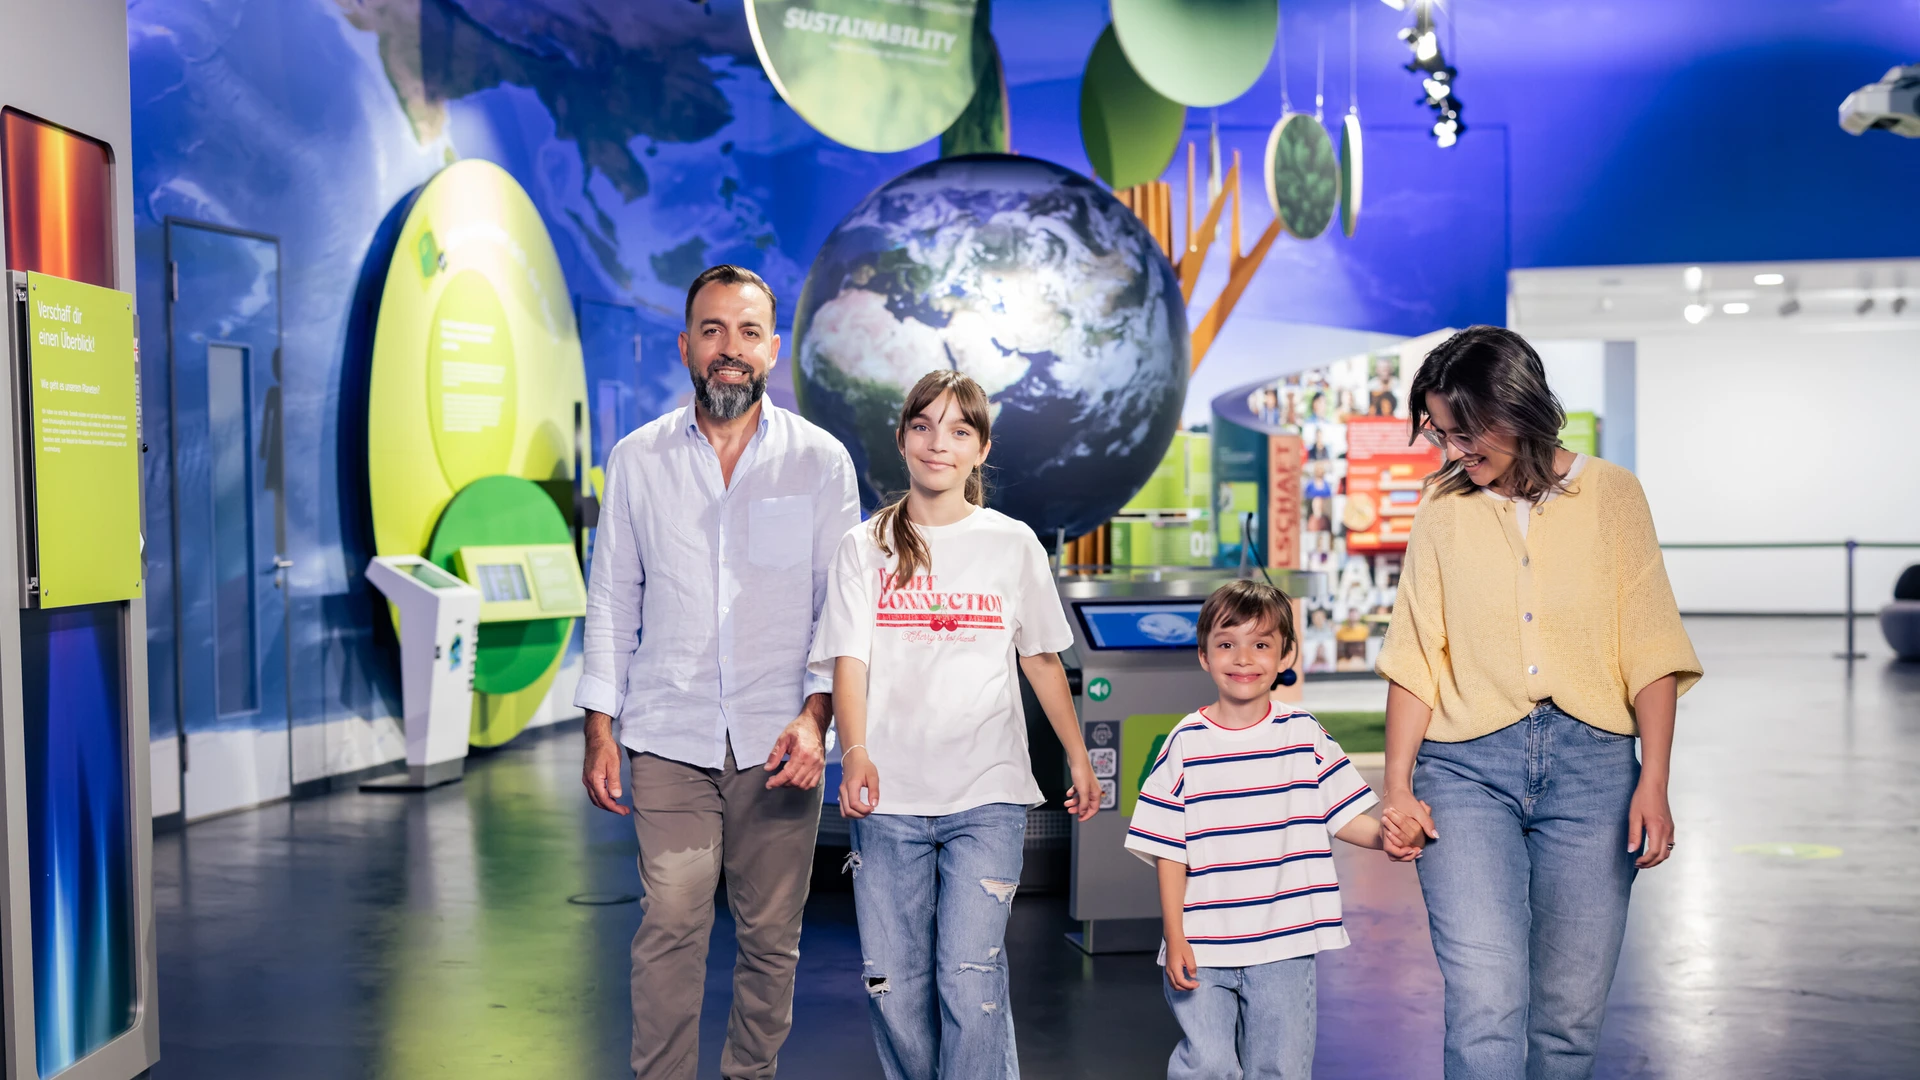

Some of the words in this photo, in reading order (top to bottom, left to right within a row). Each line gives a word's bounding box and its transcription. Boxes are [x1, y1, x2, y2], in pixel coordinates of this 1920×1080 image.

[783, 7, 958, 53] SUSTAINABILITY
[37, 300, 71, 322] Verschaff
[73, 307, 82, 324] dir
[39, 329, 59, 347] einen
[61, 328, 95, 352] Überblick!
